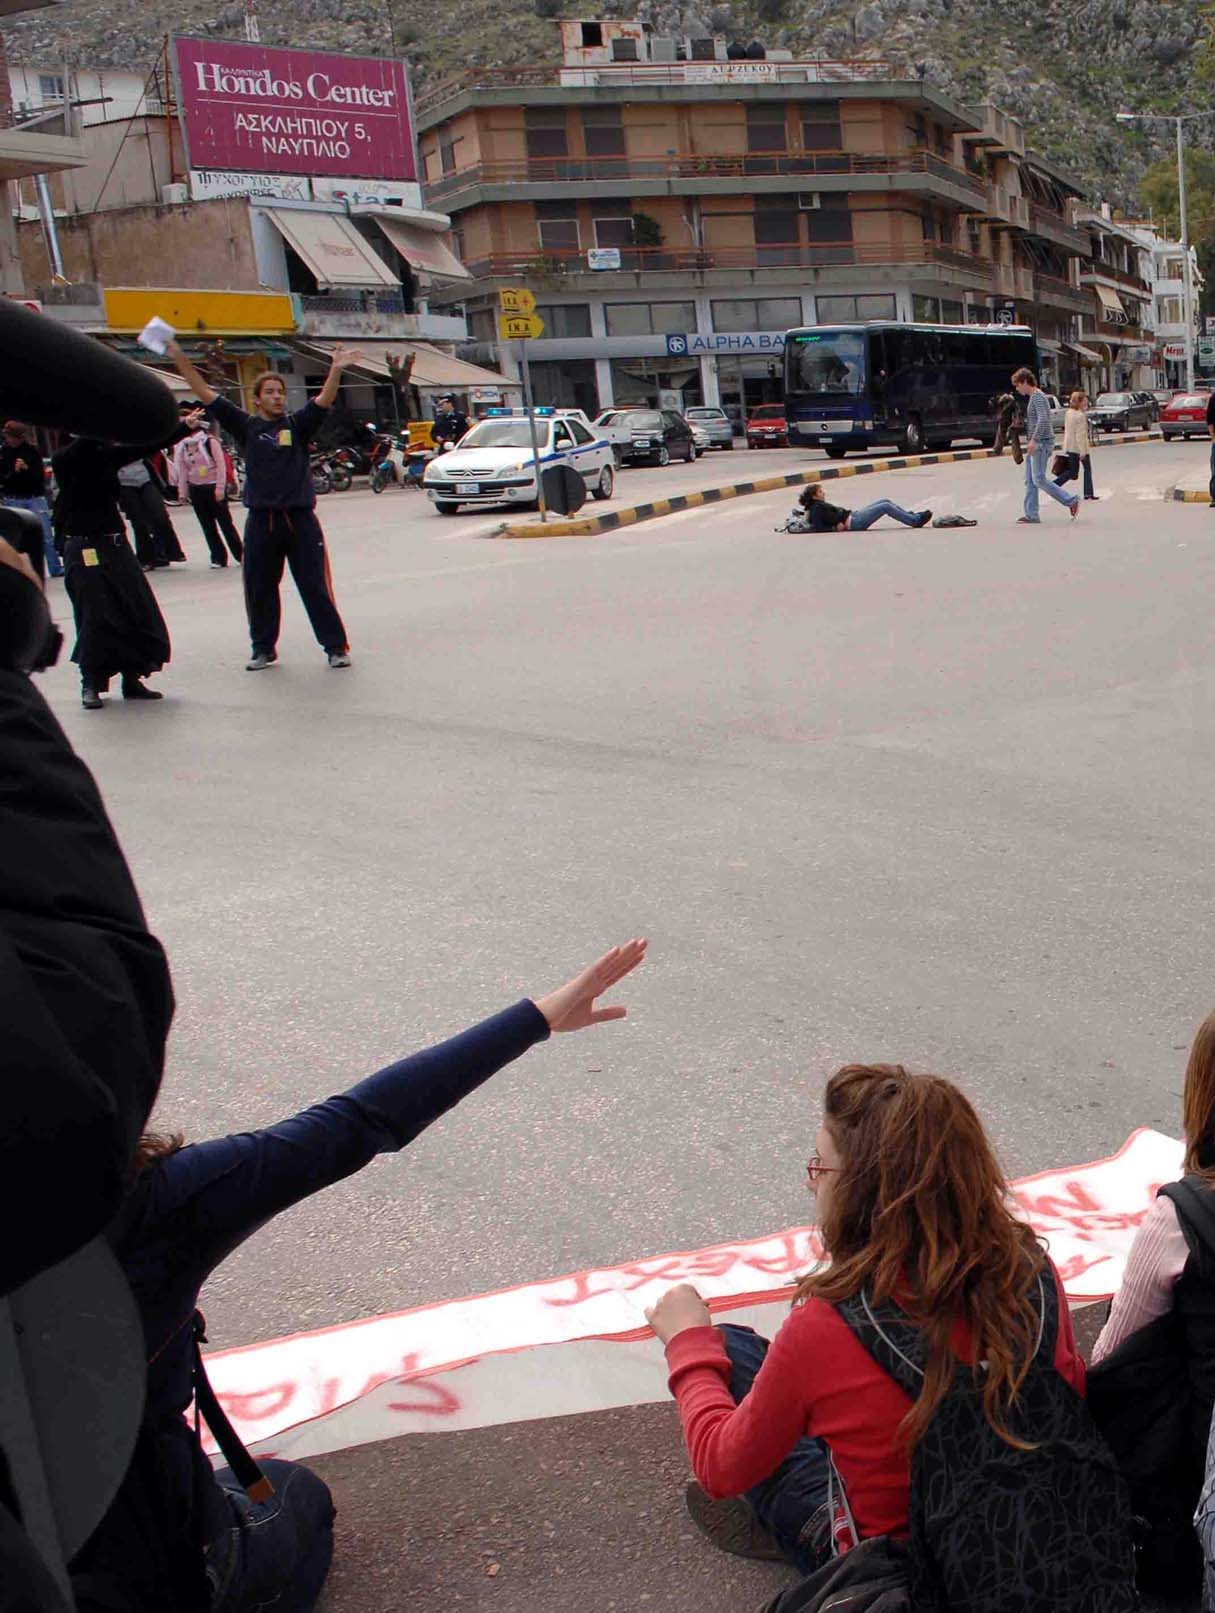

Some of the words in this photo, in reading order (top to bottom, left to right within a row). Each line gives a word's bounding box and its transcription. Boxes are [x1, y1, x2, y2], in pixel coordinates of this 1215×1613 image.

[193, 61, 303, 99] Hondos
[307, 72, 395, 107] Center
[235, 112, 349, 139] ΑΣΚΛΗΠΙΟΥ
[354, 123, 372, 142] 5,
[261, 136, 351, 159] ΝΑΥΠΛΙΟ
[692, 335, 755, 350] ALPHA
[759, 334, 787, 348] BA
